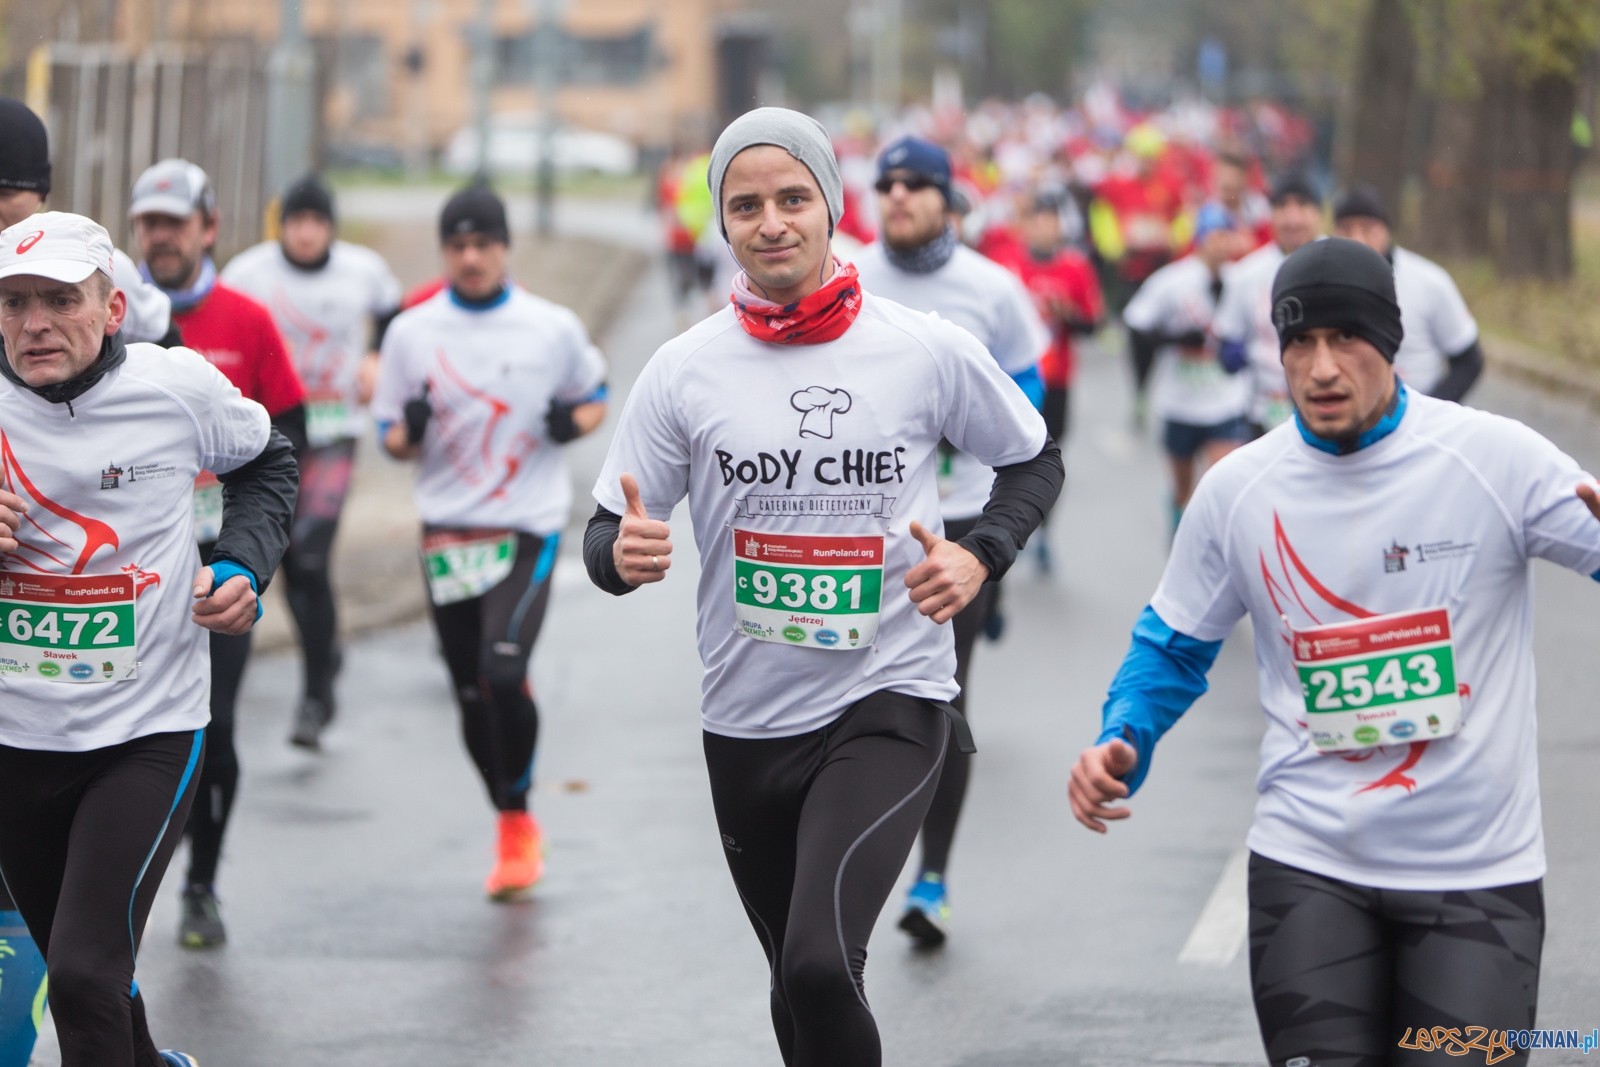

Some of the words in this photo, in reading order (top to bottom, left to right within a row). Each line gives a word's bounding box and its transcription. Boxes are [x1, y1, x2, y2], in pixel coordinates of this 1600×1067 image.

[127, 465, 136, 482] 1
[715, 449, 802, 489] BODY
[814, 447, 906, 487] CHIEF
[759, 499, 804, 512] CATERING
[809, 498, 872, 512] DIETETYCZNY
[813, 549, 875, 558] RunPoland.org
[65, 587, 125, 596] RunPoland.org
[752, 570, 862, 610] 9381
[741, 619, 762, 630] GRUPA
[788, 615, 824, 626] Jędrzej
[8, 608, 119, 646] 6472
[743, 625, 767, 637] UXMED
[1369, 624, 1441, 644] RunPoland.org
[0, 657, 18, 666] RUPA
[43, 651, 78, 660] Sławek
[0, 664, 23, 673] UXMED
[1309, 653, 1442, 710] 2543
